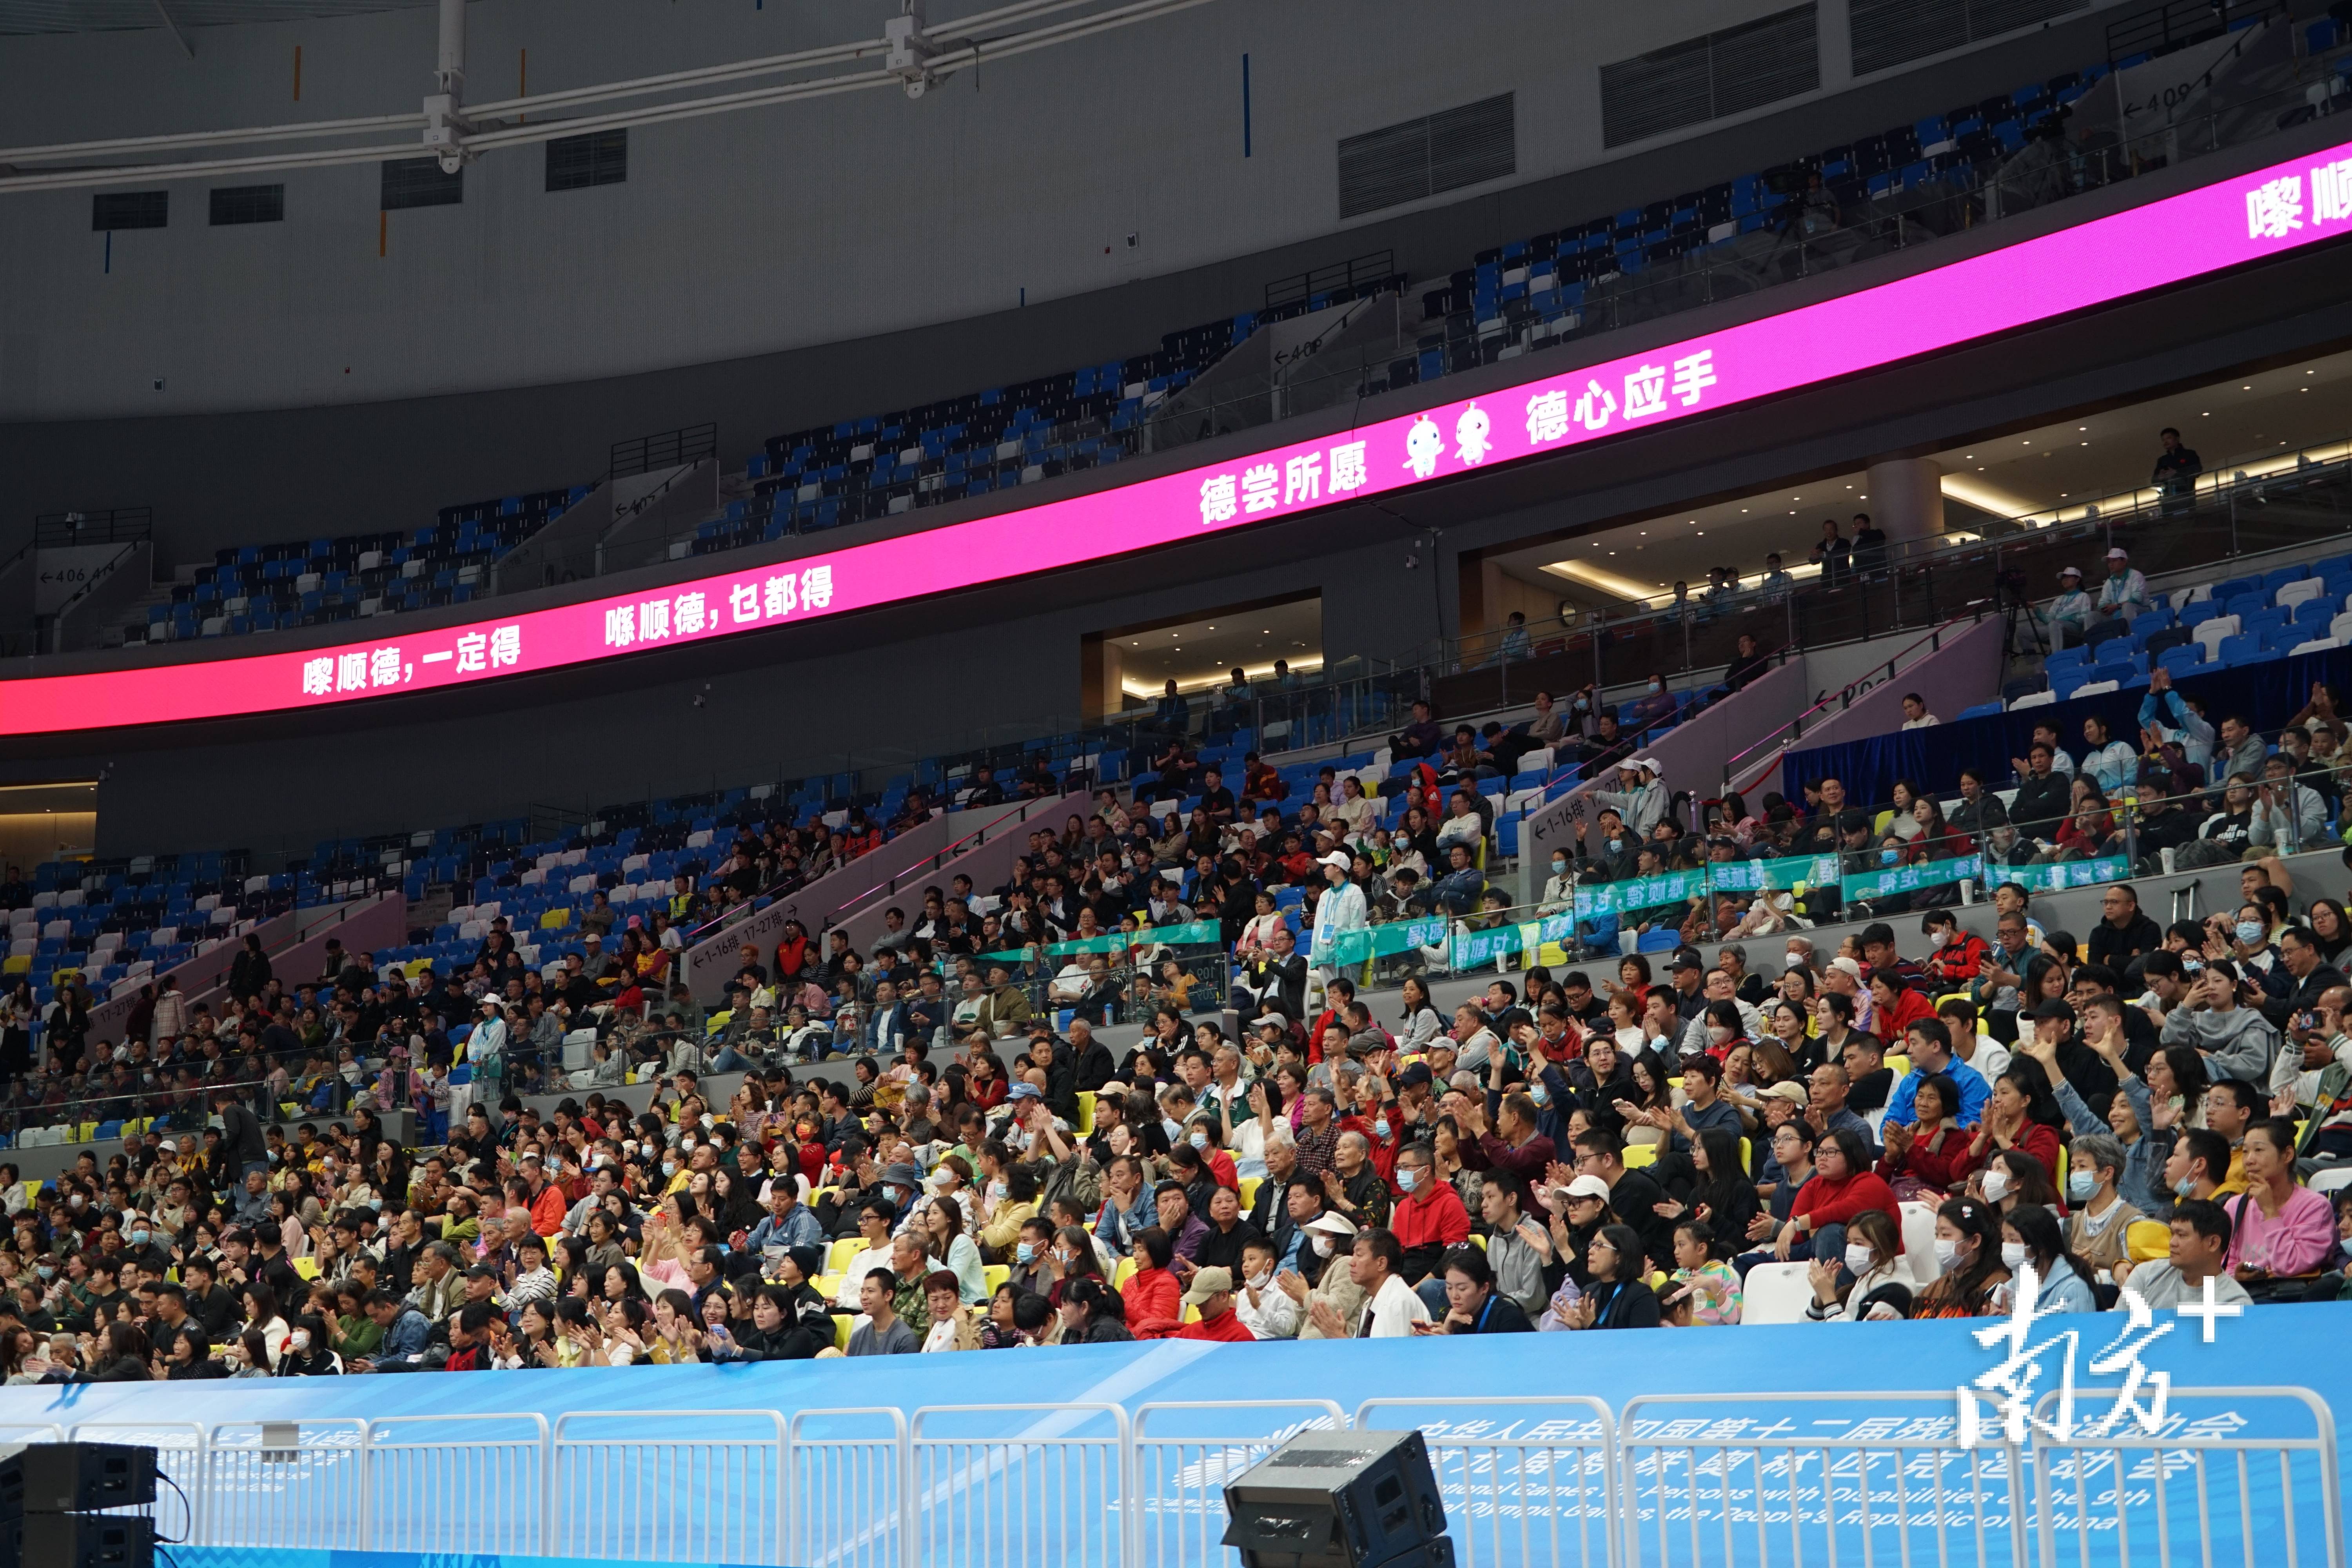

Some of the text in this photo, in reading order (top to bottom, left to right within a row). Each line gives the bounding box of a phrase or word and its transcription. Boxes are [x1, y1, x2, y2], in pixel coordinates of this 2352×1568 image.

[1525, 349, 1717, 445] 德心应手
[1200, 440, 1367, 525] 德尝所愿
[56, 568, 85, 583] 406
[1546, 799, 1584, 833] 1-16排
[705, 910, 783, 963] 1-16排 17-27排
[1639, 1485, 1754, 1500] Persons
[2030, 1488, 2086, 1505] he
